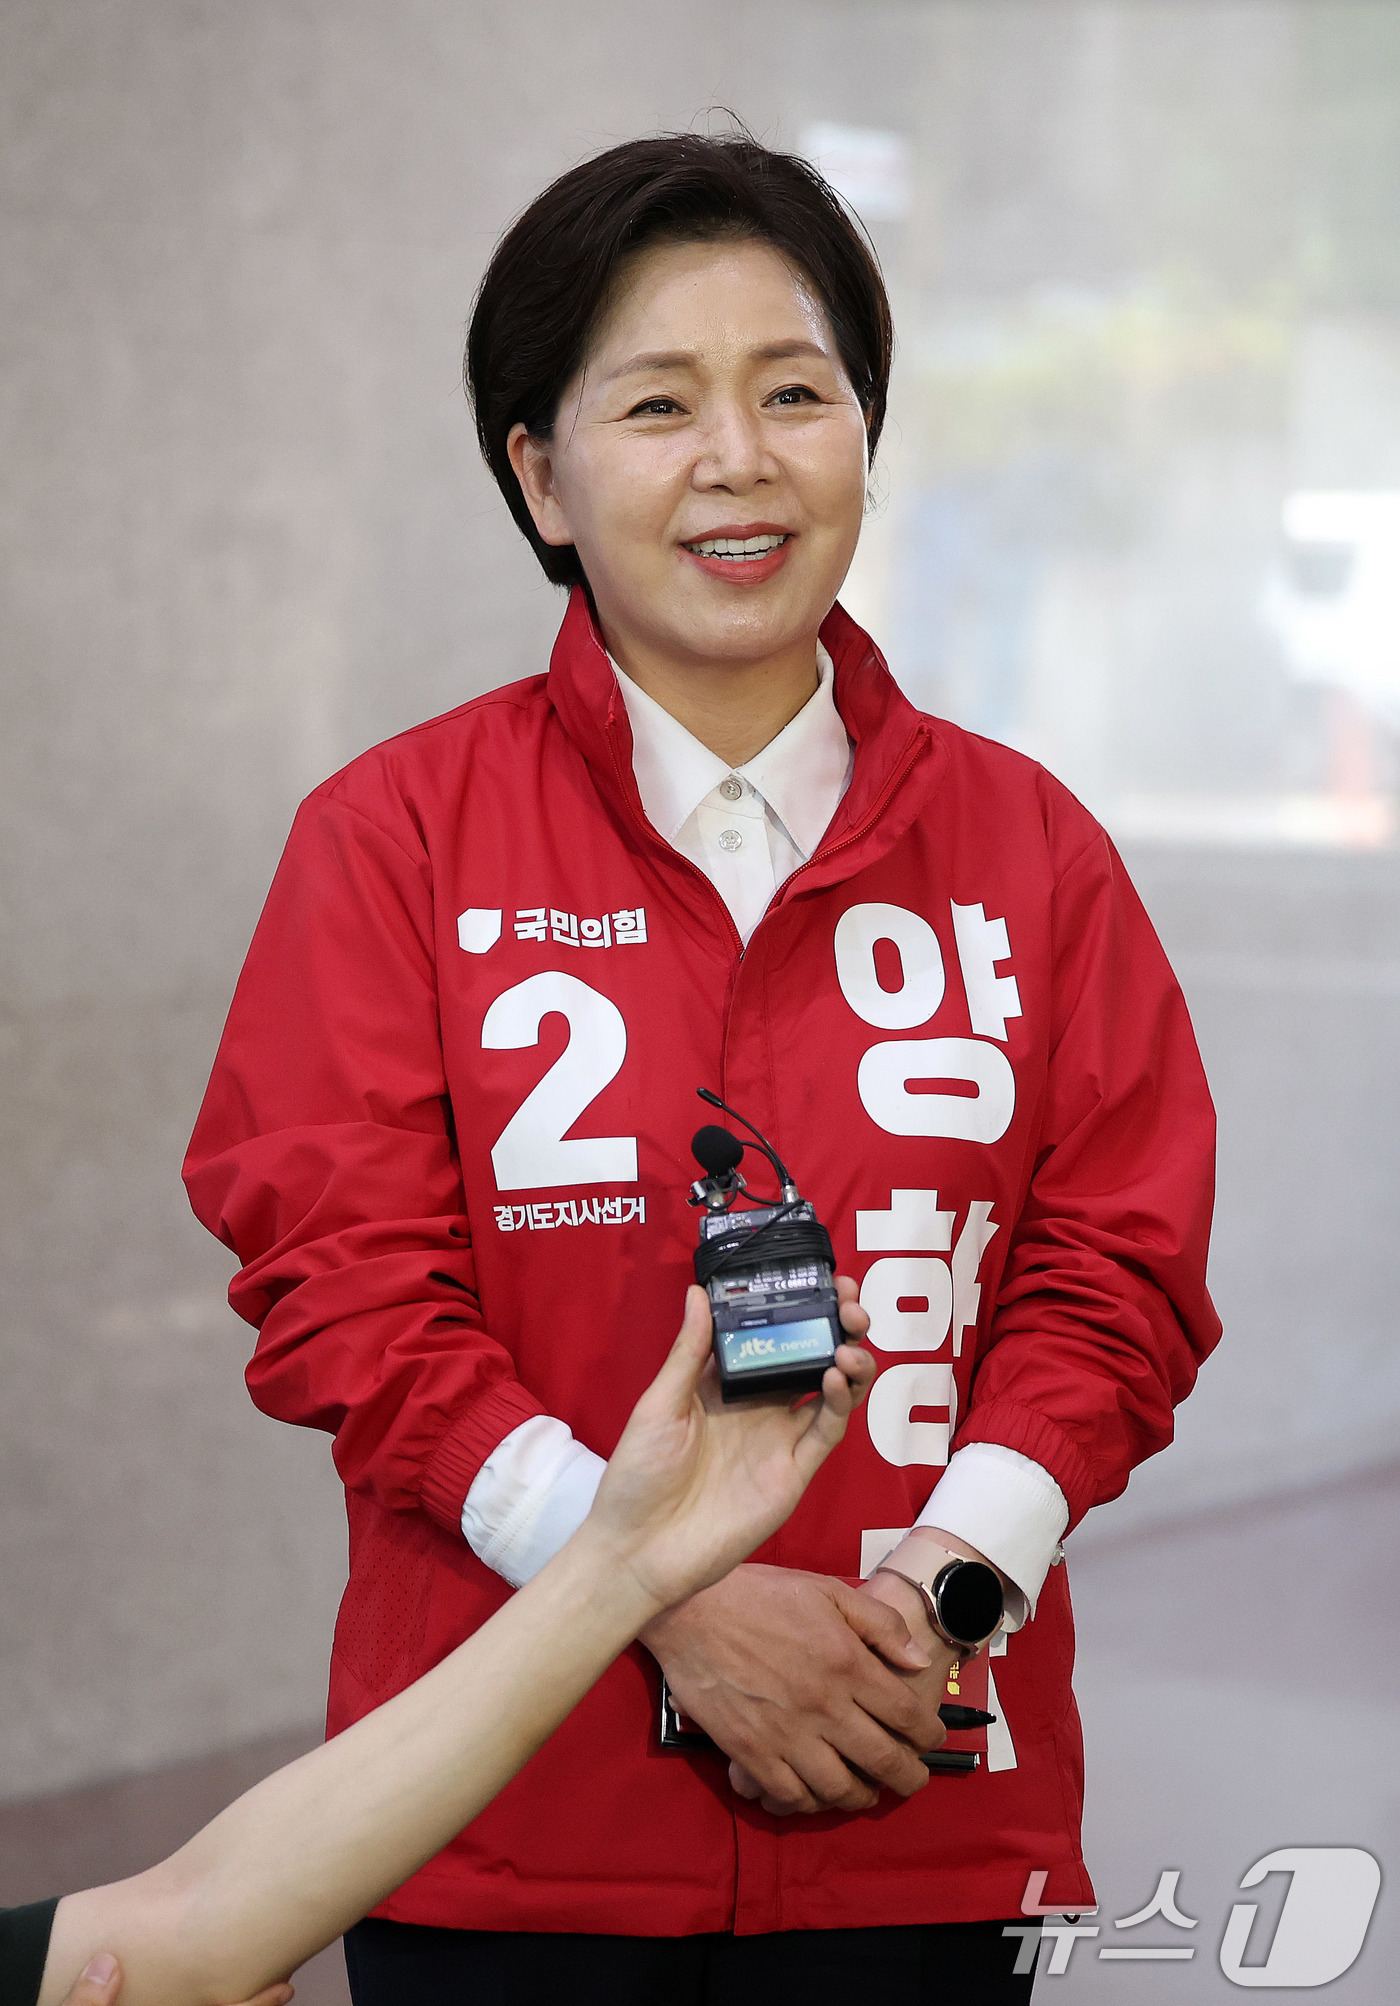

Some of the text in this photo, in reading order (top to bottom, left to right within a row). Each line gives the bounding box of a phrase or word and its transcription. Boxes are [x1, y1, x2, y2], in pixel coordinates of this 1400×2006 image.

[513, 907, 648, 949] 국민의힘
[481, 970, 638, 1191] 2
[493, 1196, 646, 1232] 경기도지사선거
[834, 898, 1023, 1773] 양향
